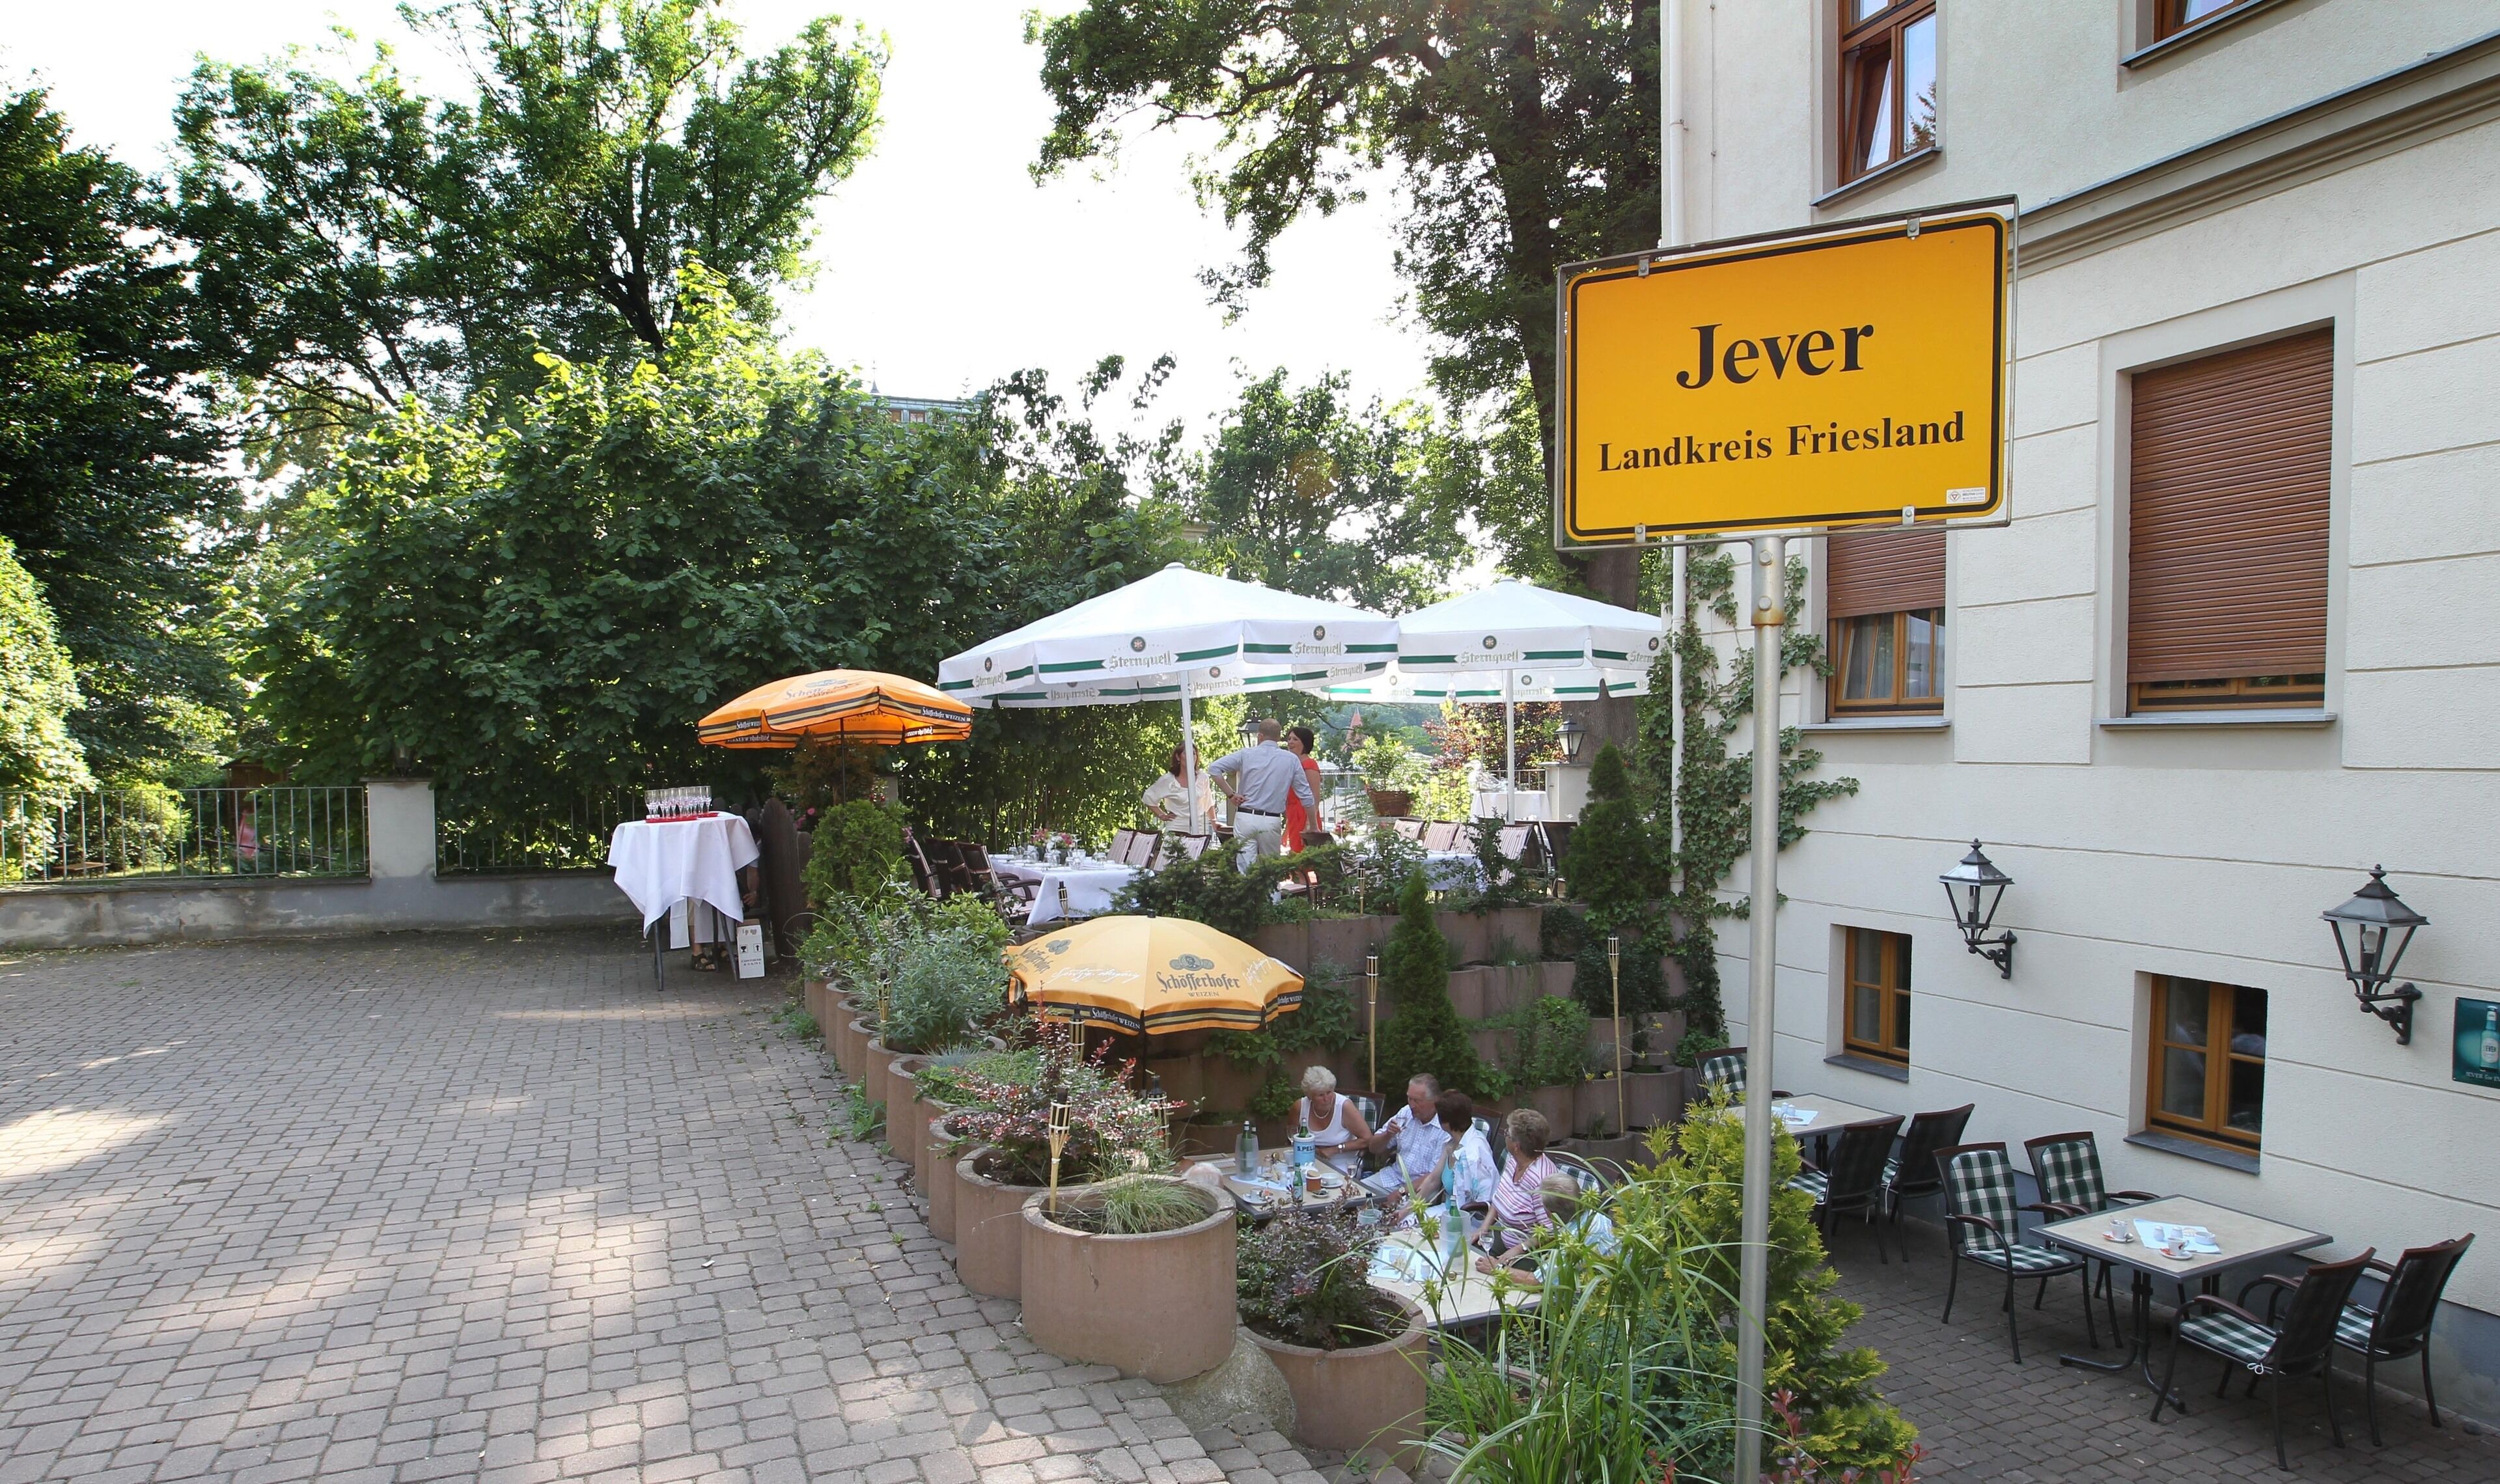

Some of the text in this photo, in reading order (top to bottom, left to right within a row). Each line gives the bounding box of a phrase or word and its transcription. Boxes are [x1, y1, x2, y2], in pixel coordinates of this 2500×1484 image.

[1676, 323, 1874, 390] Jever
[1597, 411, 1965, 472] Landkreis Friesland
[1294, 641, 1342, 657] Sternquell
[1460, 648, 1520, 666] Sternquell
[1109, 651, 1171, 672] Sternquell
[976, 670, 1004, 691] Sternquell
[1330, 663, 1363, 680] Sternquell
[945, 713, 966, 722] WEIZEN
[1156, 970, 1241, 994] Schöfferhofer
[1118, 1017, 1141, 1029] WEIZEN
